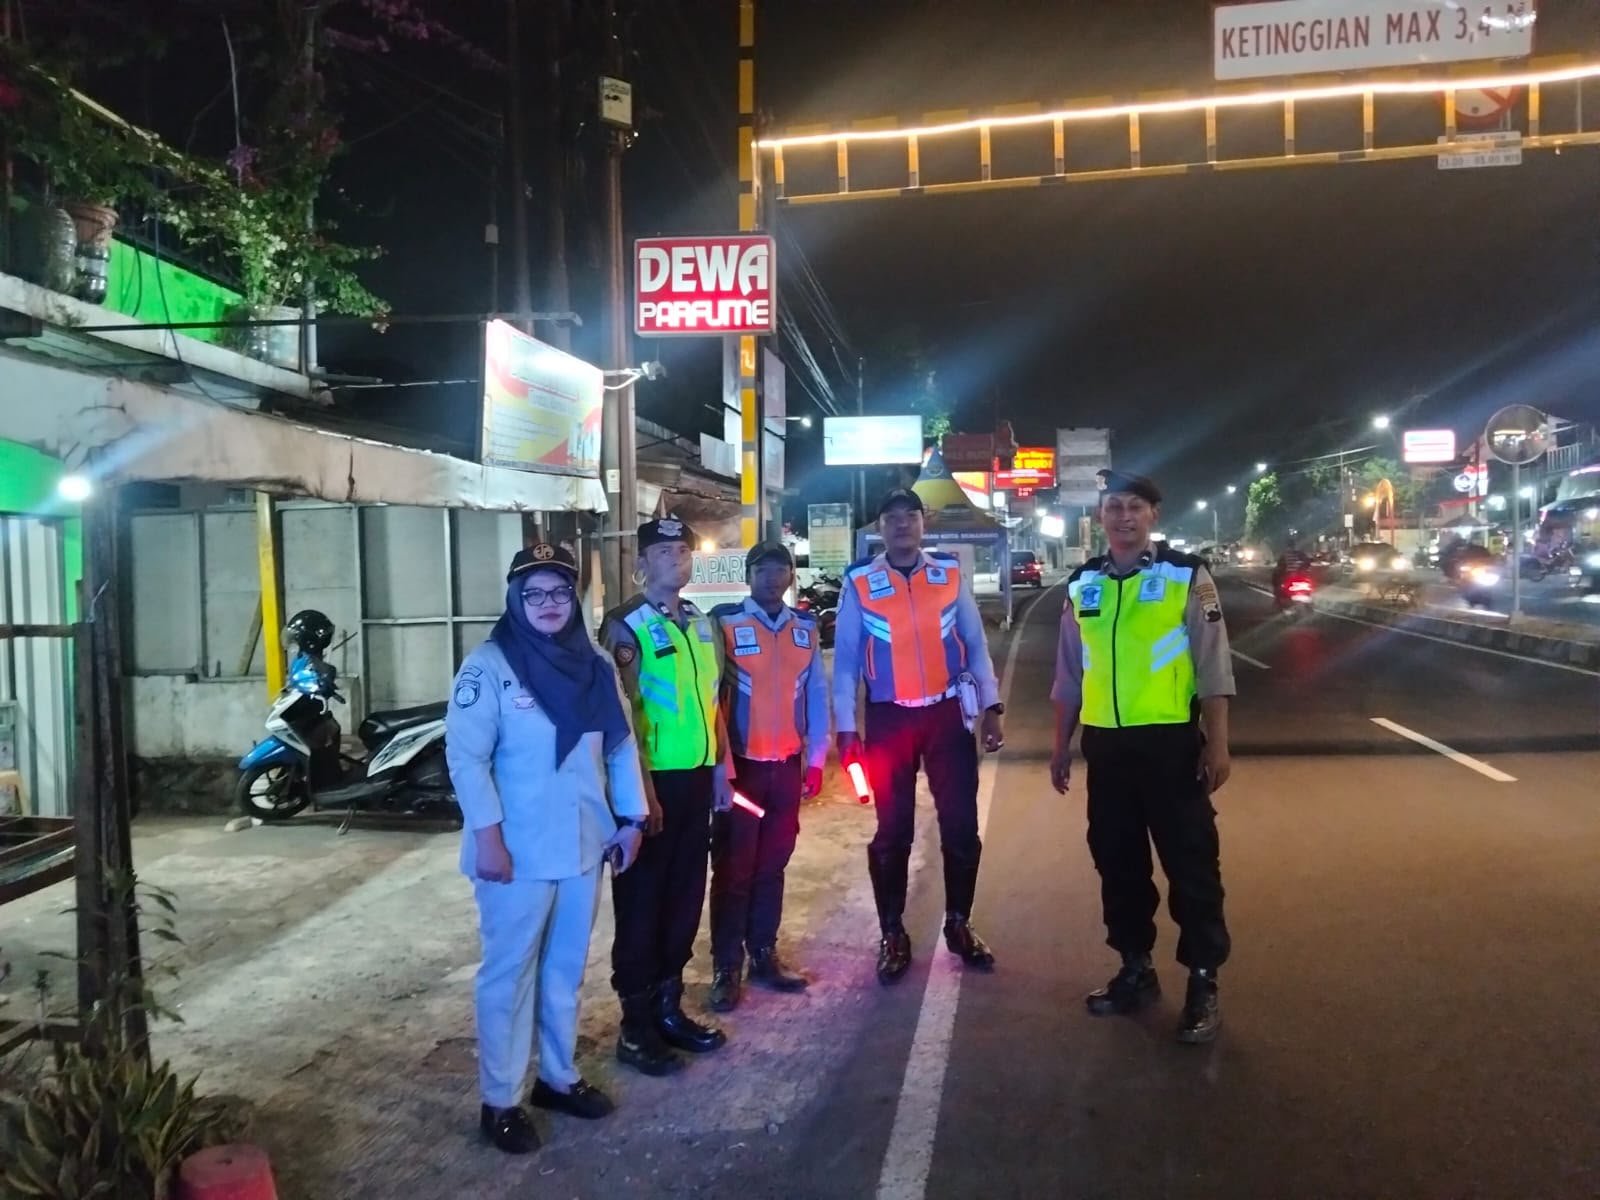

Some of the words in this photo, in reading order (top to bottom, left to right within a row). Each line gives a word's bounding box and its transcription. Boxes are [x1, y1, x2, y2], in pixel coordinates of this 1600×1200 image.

[1222, 15, 1370, 59] KETINGGIAN
[1386, 10, 1441, 45] MAX
[1455, 6, 1492, 43] 3,4
[638, 244, 769, 296] DEWA
[639, 299, 769, 327] PARFUME
